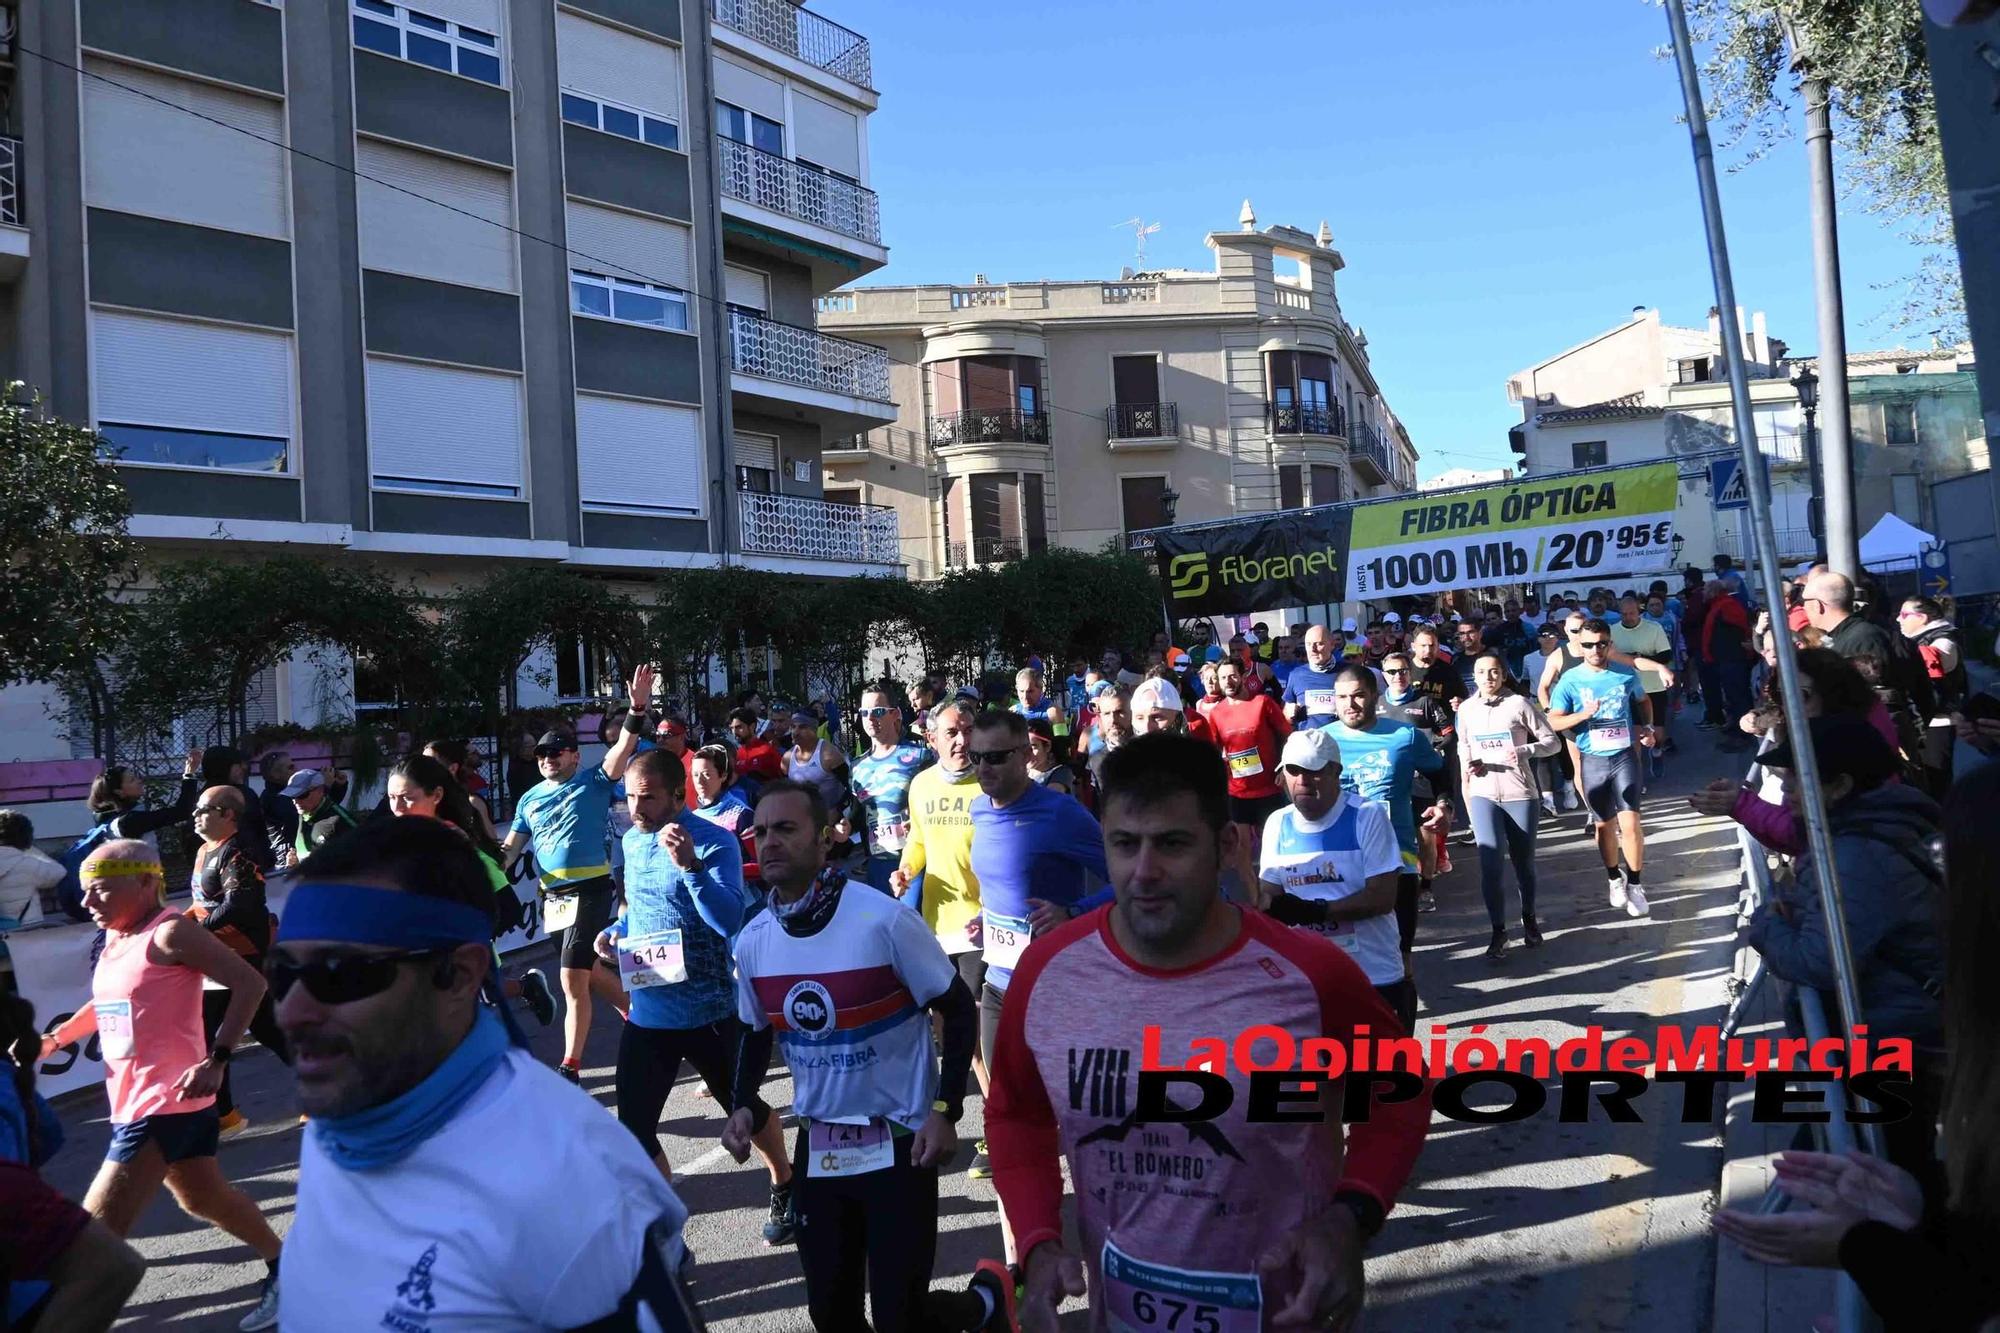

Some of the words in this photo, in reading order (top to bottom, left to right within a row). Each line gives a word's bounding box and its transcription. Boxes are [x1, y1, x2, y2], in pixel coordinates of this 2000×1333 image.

[1400, 499, 1489, 536] FIBRA
[1501, 481, 1616, 523] ÓPTICA
[1219, 545, 1337, 586] fibranet
[1367, 548, 1456, 591] 1000
[1466, 541, 1528, 580] Mb
[1358, 564, 1366, 593] HASTA
[1314, 695, 1331, 703] 704
[1600, 728, 1621, 738] 724
[1480, 739, 1503, 750] 644
[1236, 757, 1249, 766] 73
[989, 926, 1015, 946] 763
[633, 945, 667, 965] 614
[1068, 1047, 1130, 1118] VIII
[1142, 1132, 1170, 1148] TRAIL
[1132, 1290, 1221, 1333] 675
